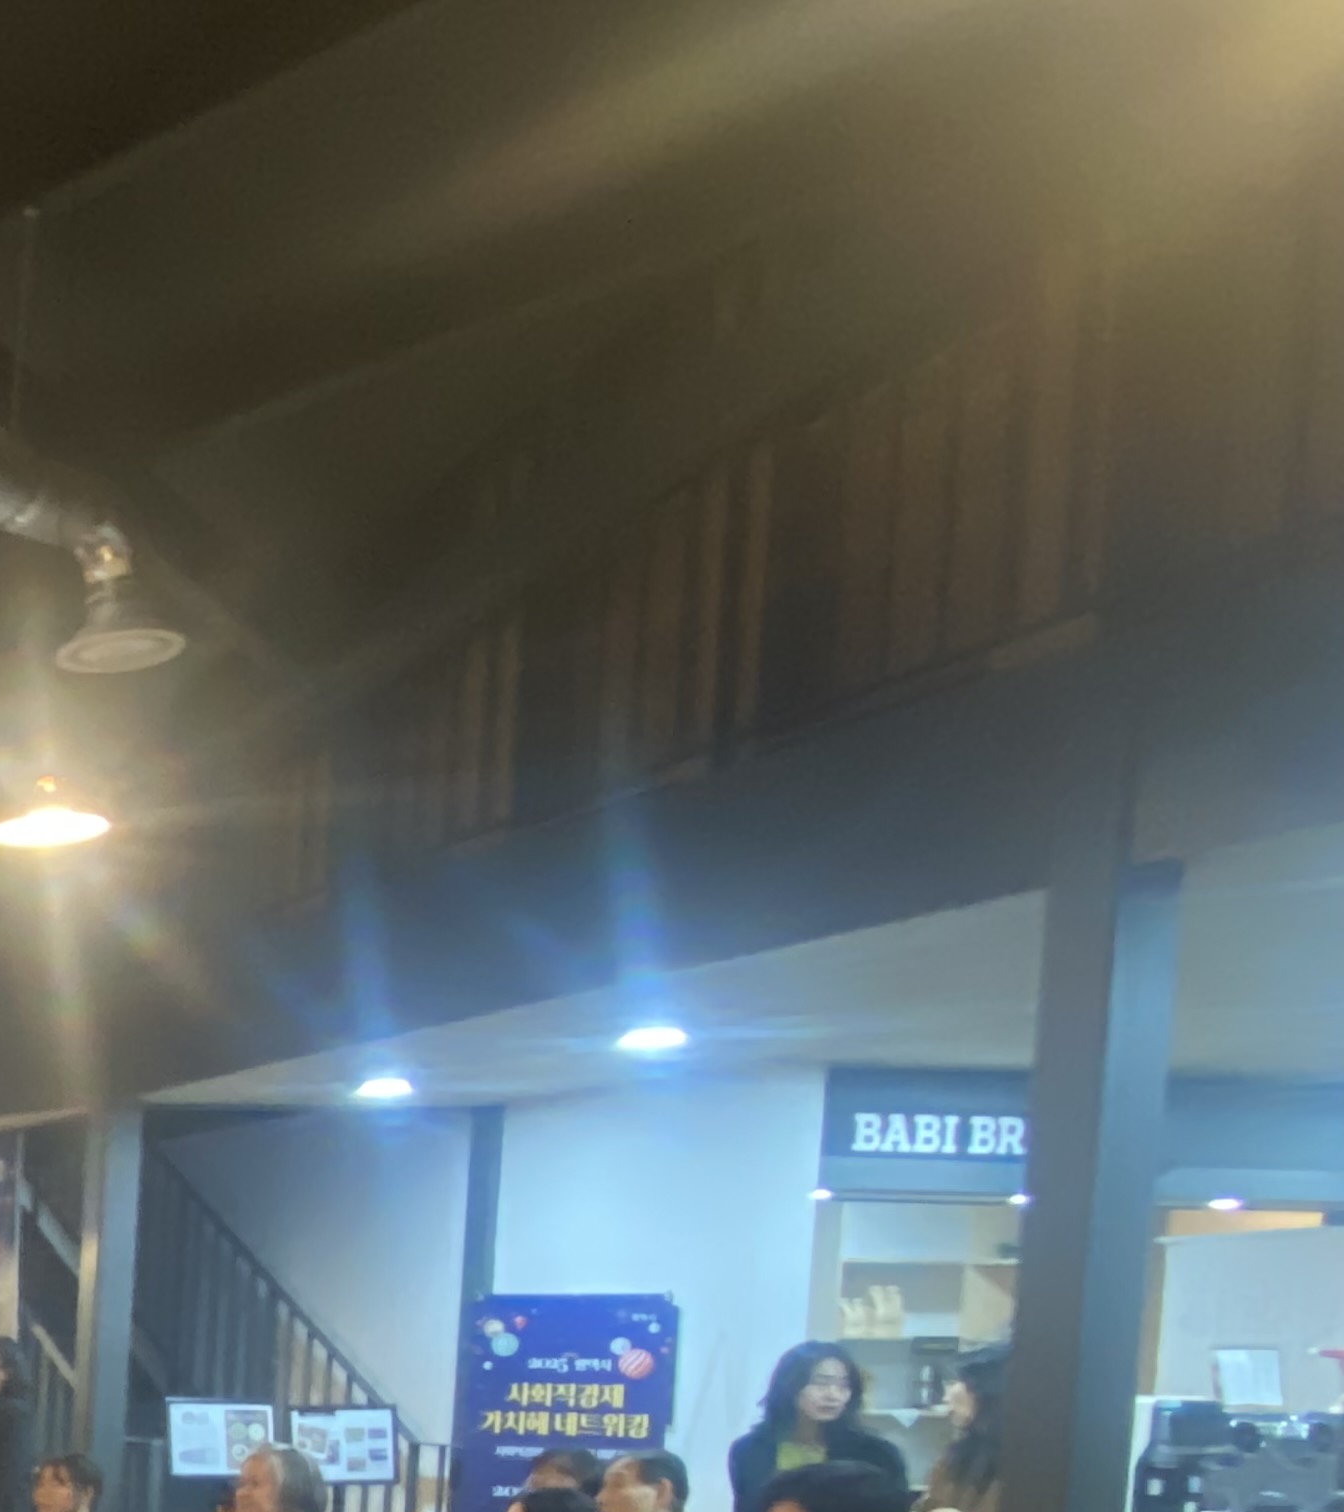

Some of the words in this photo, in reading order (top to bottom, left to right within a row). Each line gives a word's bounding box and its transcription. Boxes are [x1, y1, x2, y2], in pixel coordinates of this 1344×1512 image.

[851, 1112, 960, 1155] BABI
[966, 1114, 1028, 1156] BR
[527, 1356, 570, 1374] 2025
[505, 1381, 626, 1409] 사회적경제
[553, 1411, 650, 1440] 네트워킹
